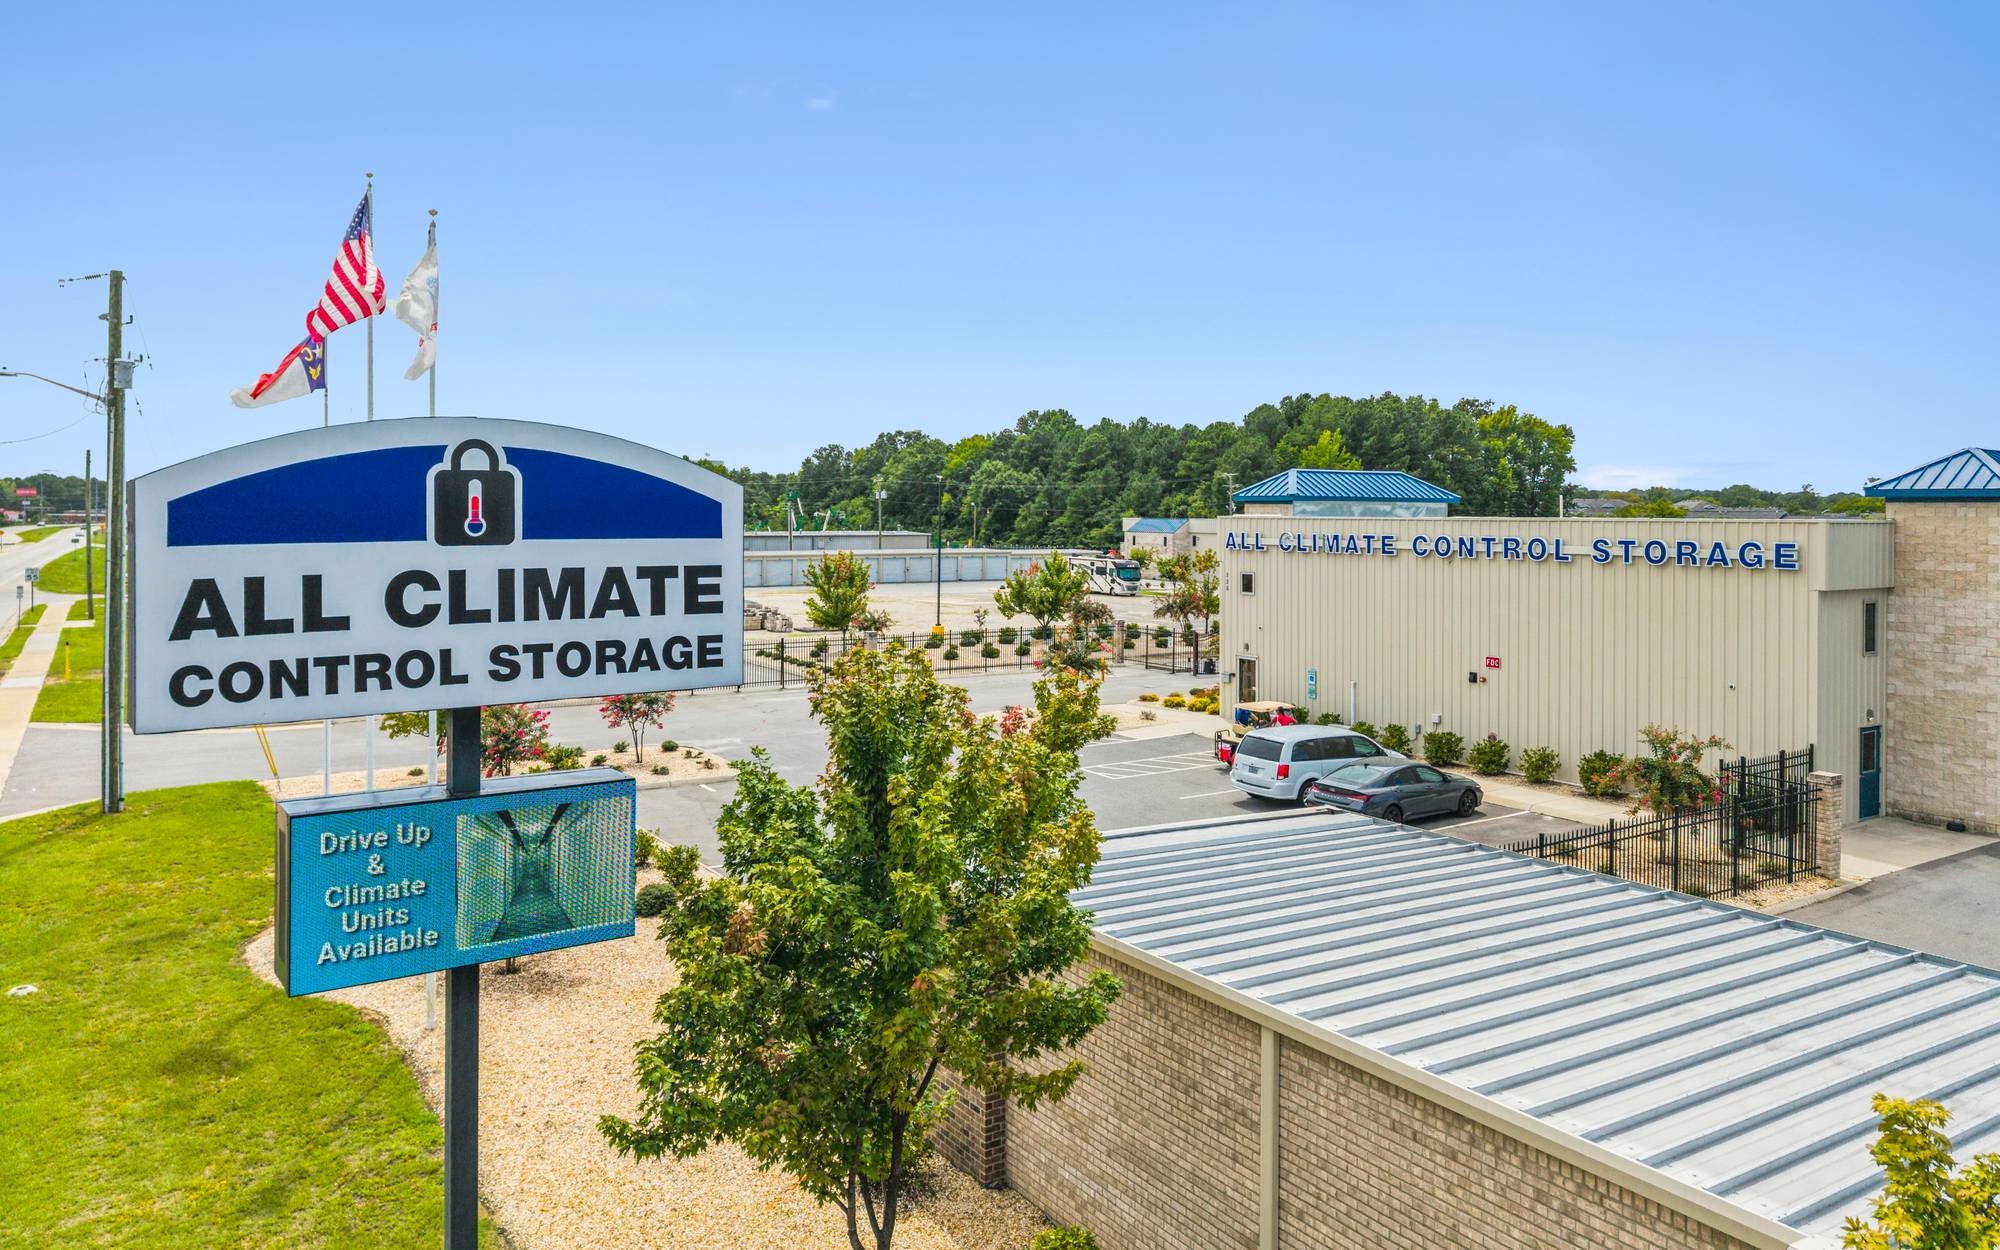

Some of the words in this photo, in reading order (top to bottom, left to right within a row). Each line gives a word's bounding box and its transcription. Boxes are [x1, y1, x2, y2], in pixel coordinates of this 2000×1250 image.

[1225, 532, 1266, 551] ALL
[1279, 532, 1398, 556] CLIMATE
[1412, 534, 1573, 562] CONTROL
[1591, 537, 1799, 570] STORAGE
[168, 574, 350, 641] ALL
[384, 565, 724, 628] CLIMATE
[169, 648, 469, 707] CONTROL
[488, 634, 723, 682] STORAGE
[1486, 658, 1499, 667] FDC
[320, 829, 388, 855] Drive
[397, 822, 431, 848] Up
[367, 854, 385, 875] &
[324, 878, 426, 908] Climate
[342, 907, 409, 933] Units
[317, 927, 439, 965] Available
